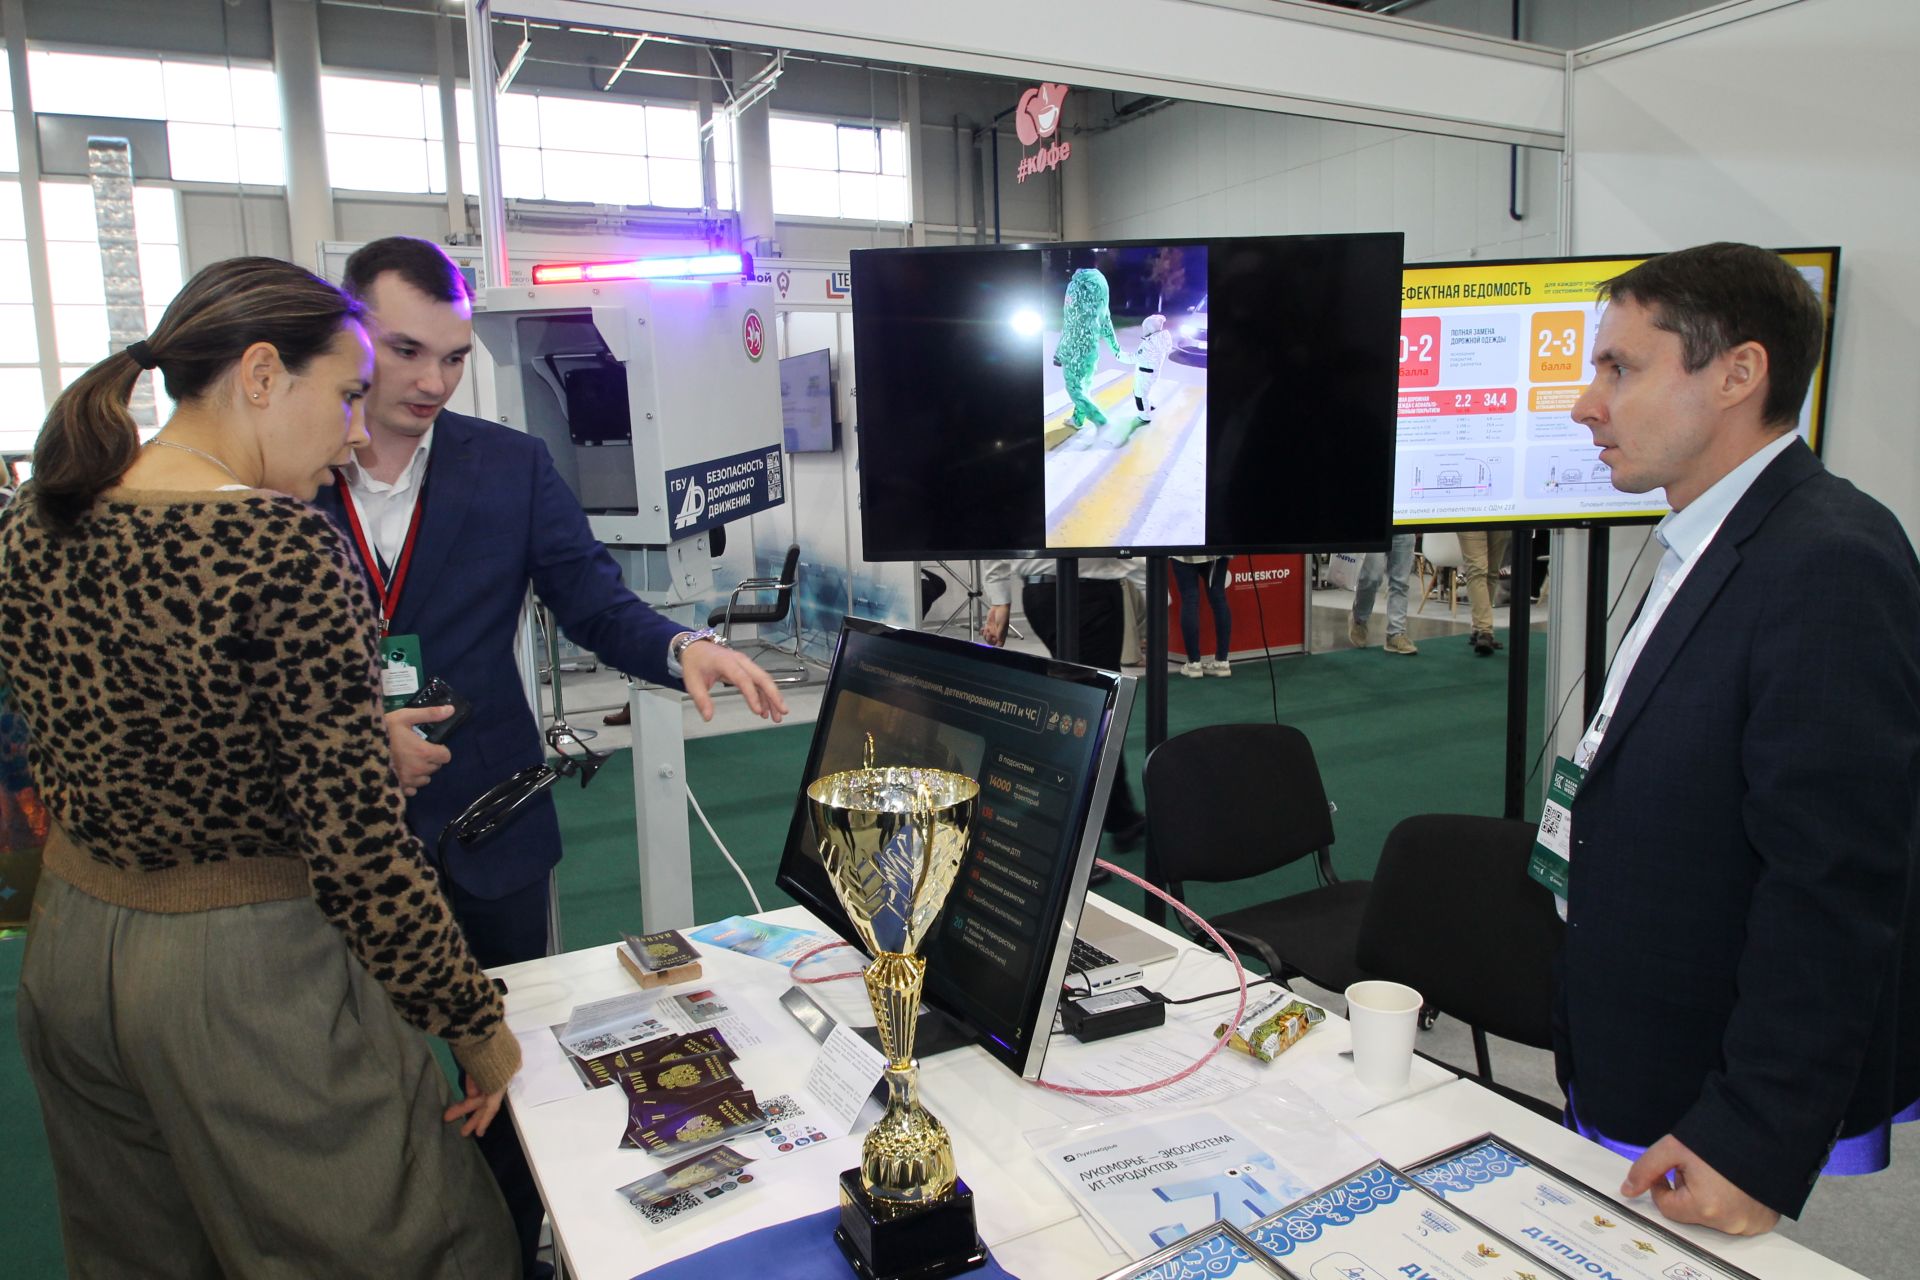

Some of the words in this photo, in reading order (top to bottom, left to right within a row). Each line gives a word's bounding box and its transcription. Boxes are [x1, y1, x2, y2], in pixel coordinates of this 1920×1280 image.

[1463, 281, 1531, 299] ВЕДОМОСТЬ
[1538, 328, 1576, 358] 2-3
[1541, 360, 1573, 371] балла
[1455, 394, 1472, 408] 2.2
[706, 458, 764, 484] БЕЗОПАСНОСТЬ
[670, 477, 687, 493] ГБУ
[707, 476, 755, 503] ДОРОЖНОГО
[708, 493, 751, 519] ДВИЖЕНИЯ
[1235, 568, 1290, 583] RUDESKTOP
[944, 687, 1000, 710] детектирования
[1000, 701, 1017, 715] ДТП
[1025, 708, 1037, 720] ЧС
[989, 774, 1011, 792] 14000
[1079, 1154, 1148, 1182] ЛУКОМОРЬЕ
[1157, 1133, 1234, 1160] ЭКОСИСТЕМА
[1087, 1160, 1178, 1192] ИТ-ПРОДУКТОВ
[1521, 1226, 1623, 1280] ДИПЛОМ
